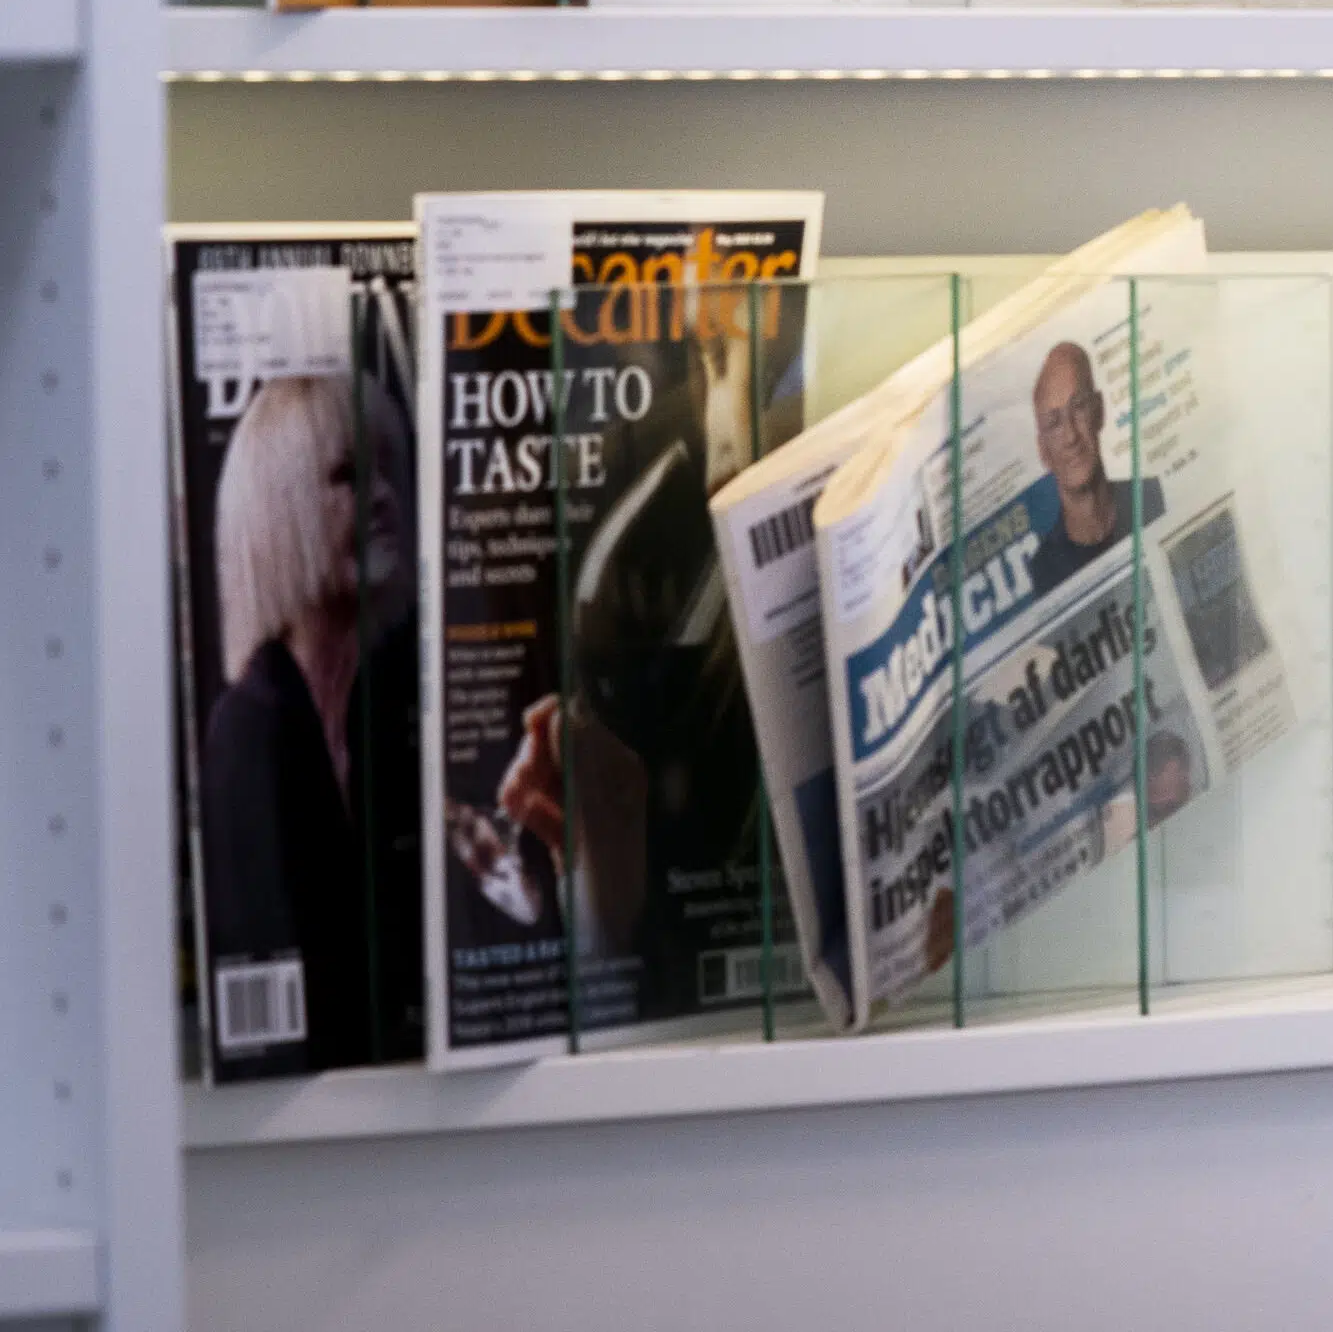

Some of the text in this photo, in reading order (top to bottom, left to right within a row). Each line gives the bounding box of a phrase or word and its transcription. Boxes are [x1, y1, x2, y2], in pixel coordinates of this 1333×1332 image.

[449, 364, 653, 429] HOW TO
[448, 433, 608, 496] TASTE
[1007, 658, 1049, 732] af
